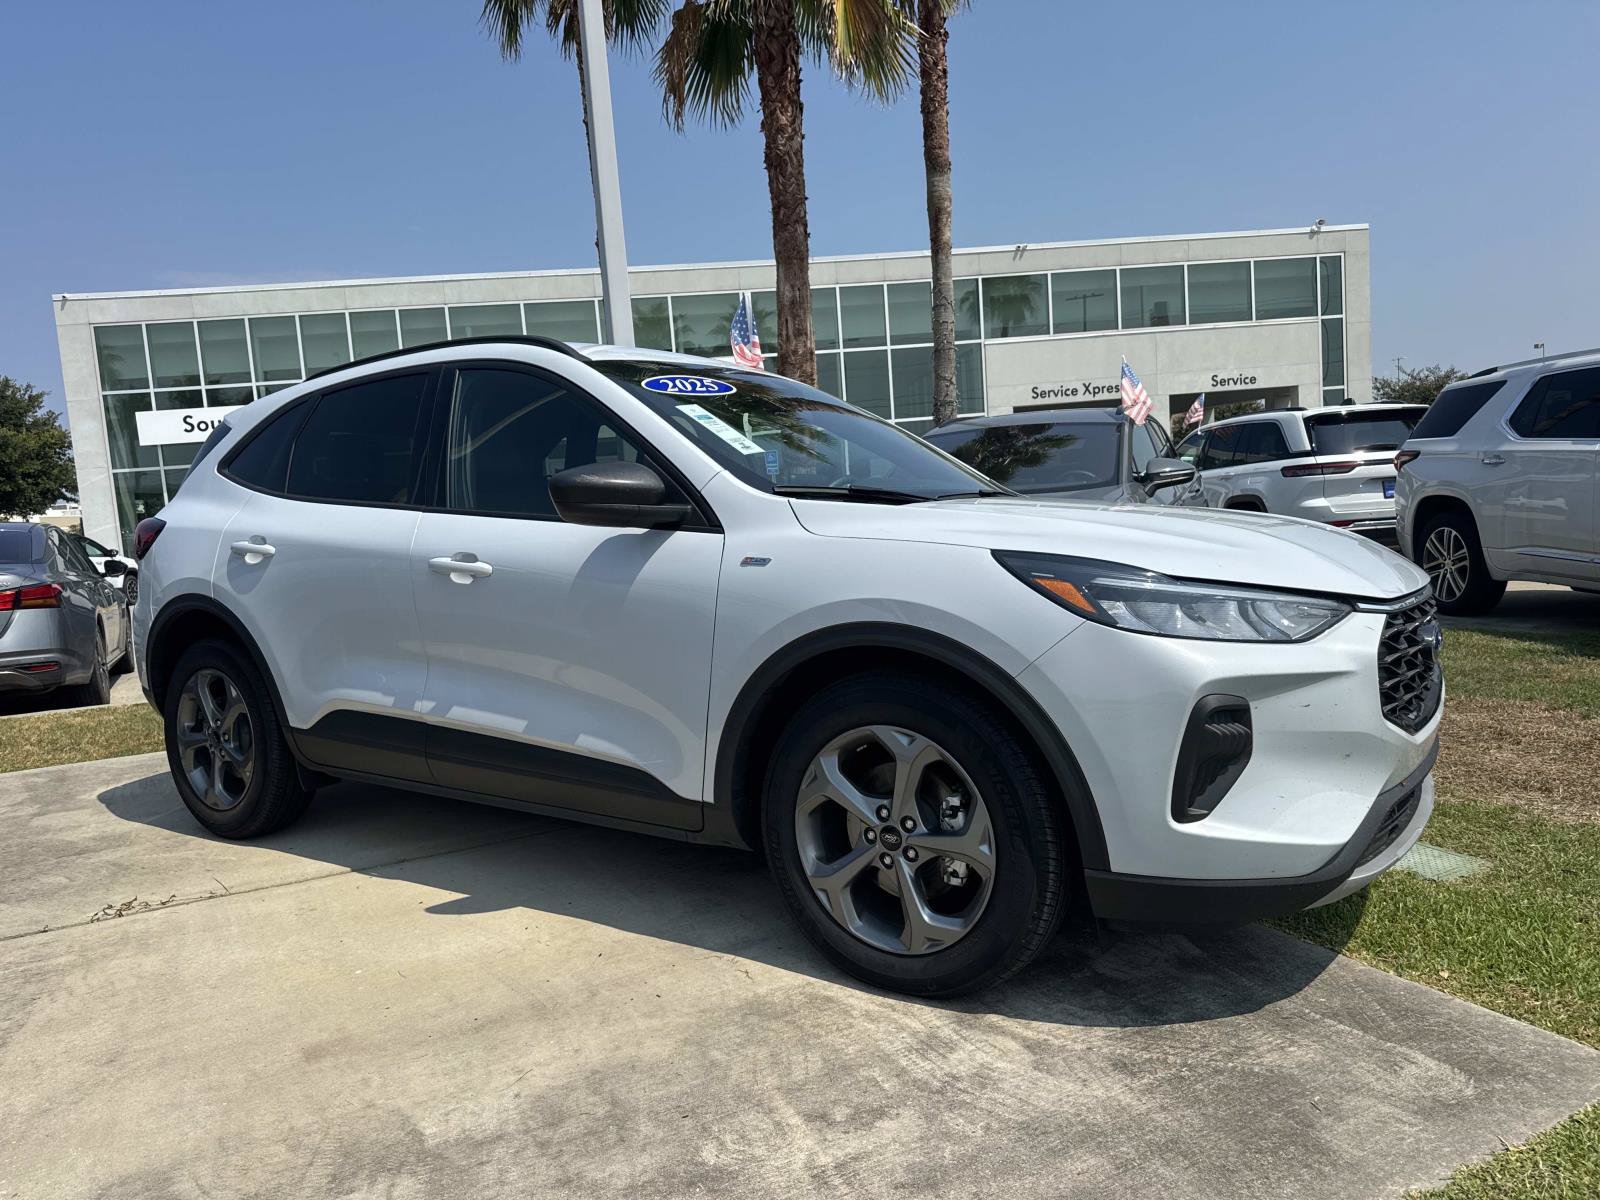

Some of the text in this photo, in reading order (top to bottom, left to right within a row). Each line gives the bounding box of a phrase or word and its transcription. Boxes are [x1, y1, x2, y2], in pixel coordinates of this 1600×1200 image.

[659, 378, 719, 392] 2025
[1211, 373, 1257, 387] Service
[1031, 385, 1079, 399] Service
